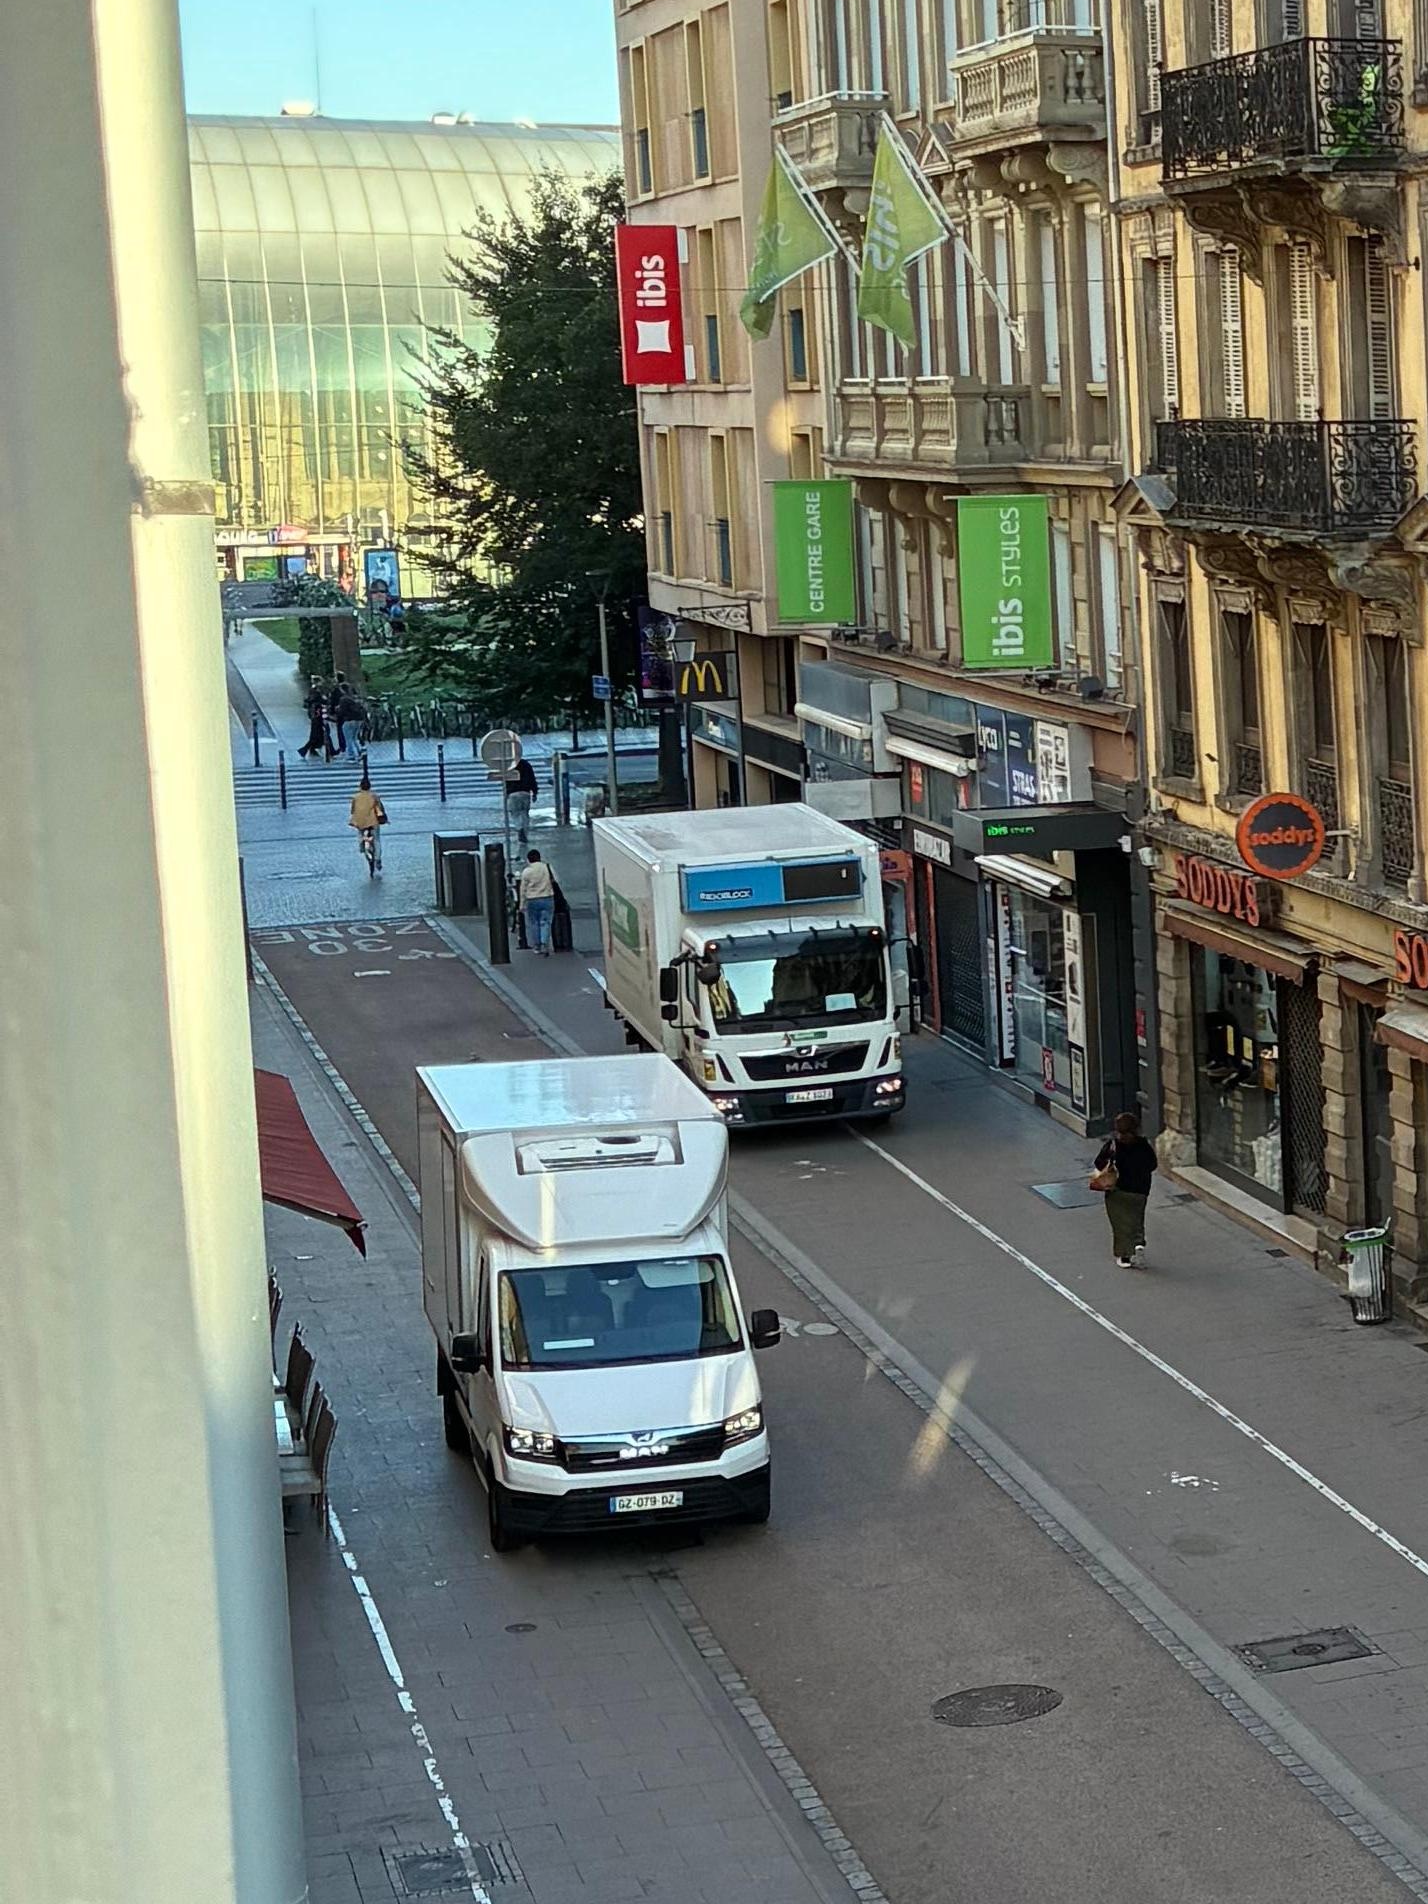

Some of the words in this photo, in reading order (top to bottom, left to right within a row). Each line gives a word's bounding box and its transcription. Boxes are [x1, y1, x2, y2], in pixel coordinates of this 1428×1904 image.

[635, 254, 667, 307] ibis
[806, 491, 823, 540] GARE
[808, 544, 825, 613] CENTRE
[991, 597, 1025, 657] ibis
[1250, 825, 1315, 846] soddys
[1174, 853, 1260, 928] SODDYS
[250, 921, 429, 945] ZONE
[308, 939, 393, 956] 30
[785, 1060, 829, 1073] MAN
